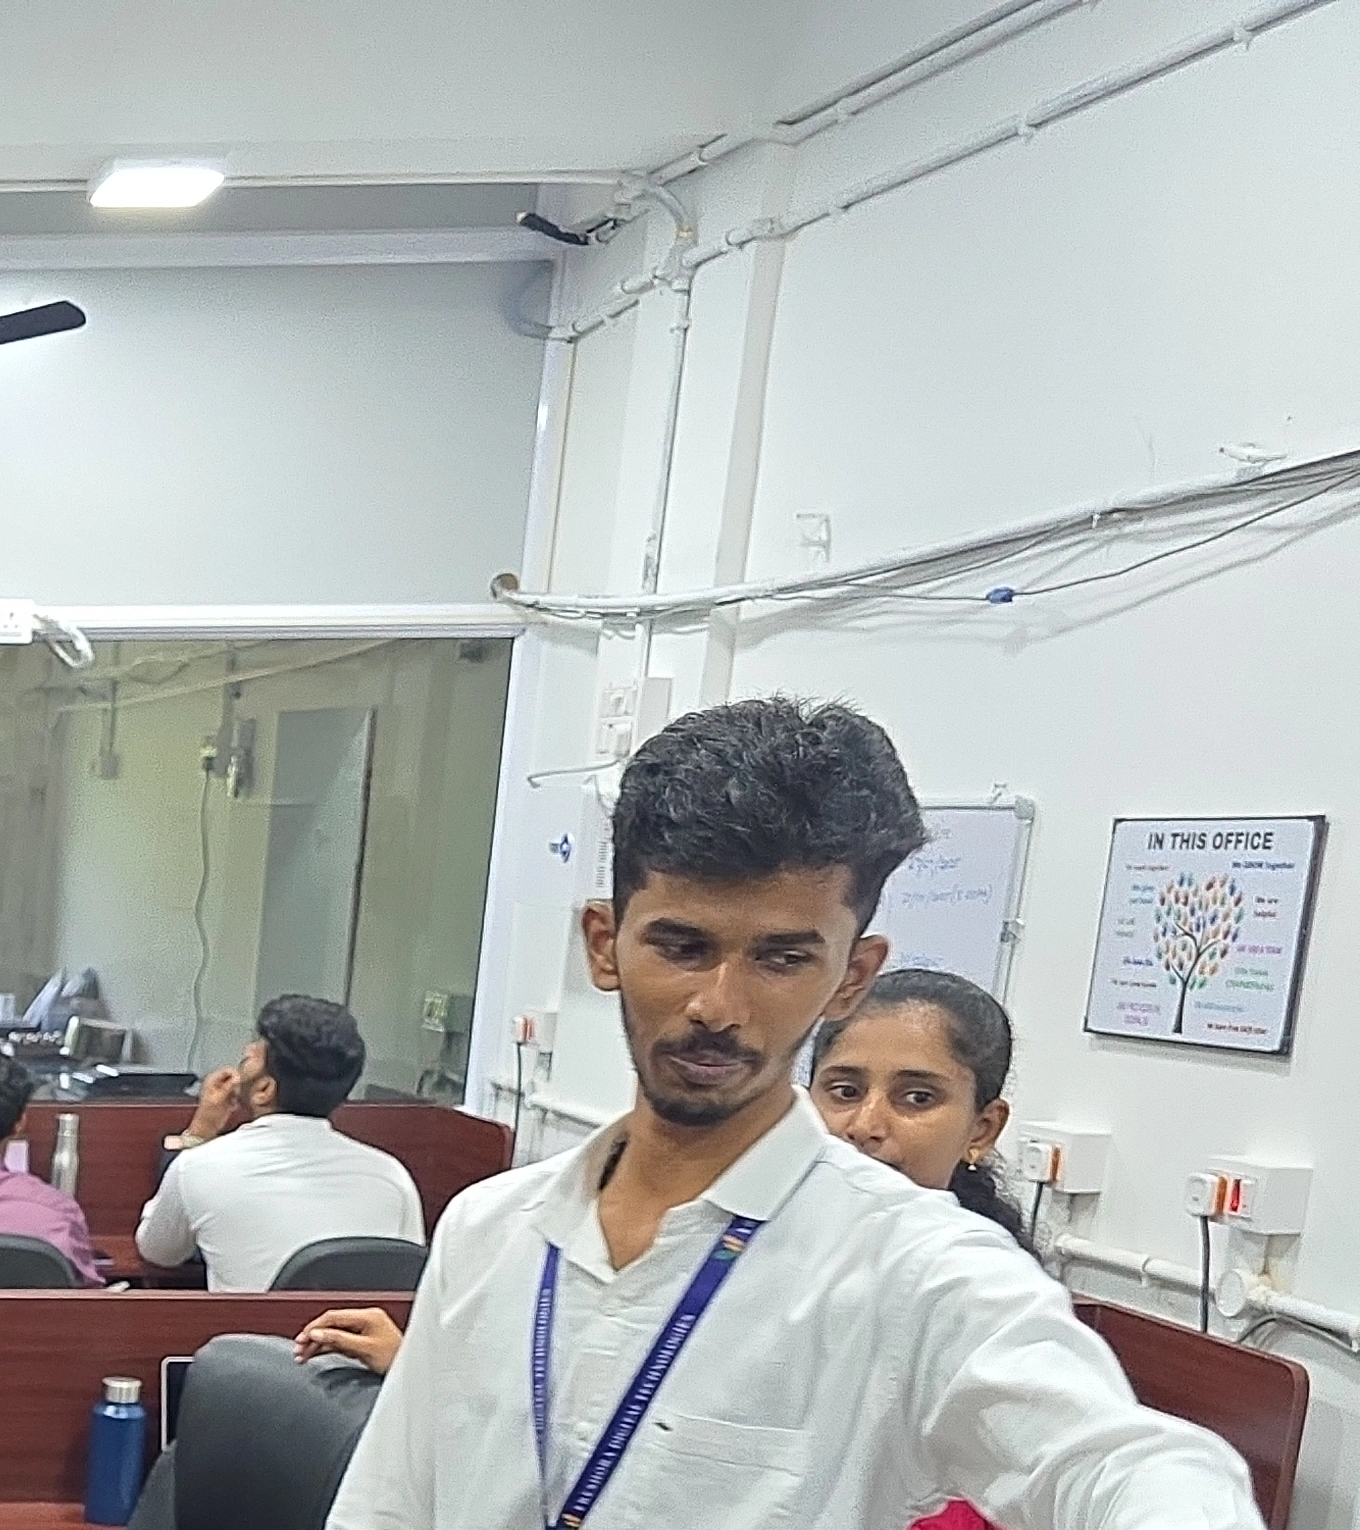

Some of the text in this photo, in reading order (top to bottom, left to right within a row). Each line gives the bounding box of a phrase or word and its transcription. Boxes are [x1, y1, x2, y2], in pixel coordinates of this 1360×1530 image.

[1147, 831, 1274, 850] IN THIS OFFICE
[634, 1314, 697, 1400] TECHNOLOGIES
